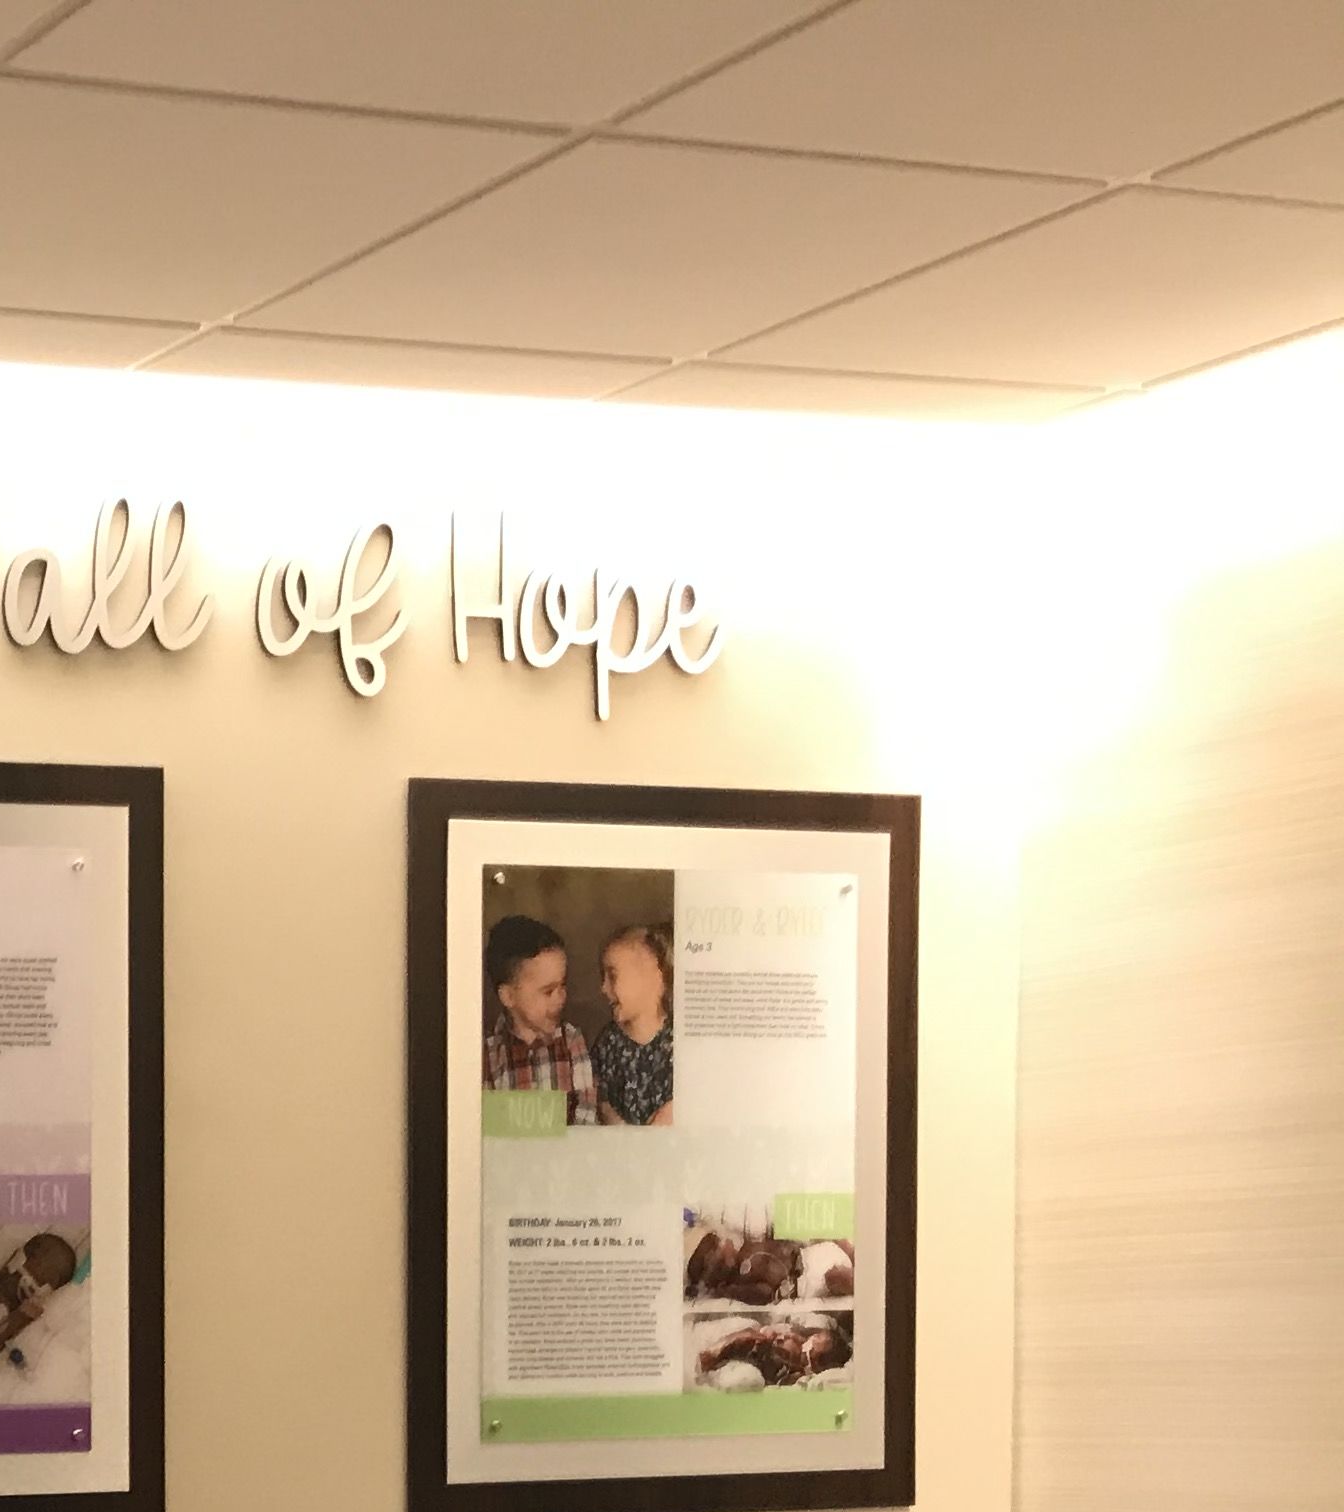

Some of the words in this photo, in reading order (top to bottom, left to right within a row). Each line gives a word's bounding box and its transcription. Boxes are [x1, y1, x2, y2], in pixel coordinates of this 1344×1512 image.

[255, 522, 412, 698] of
[449, 510, 726, 721] Hope
[684, 941, 704, 953] Age
[7, 1181, 70, 1217] THEN
